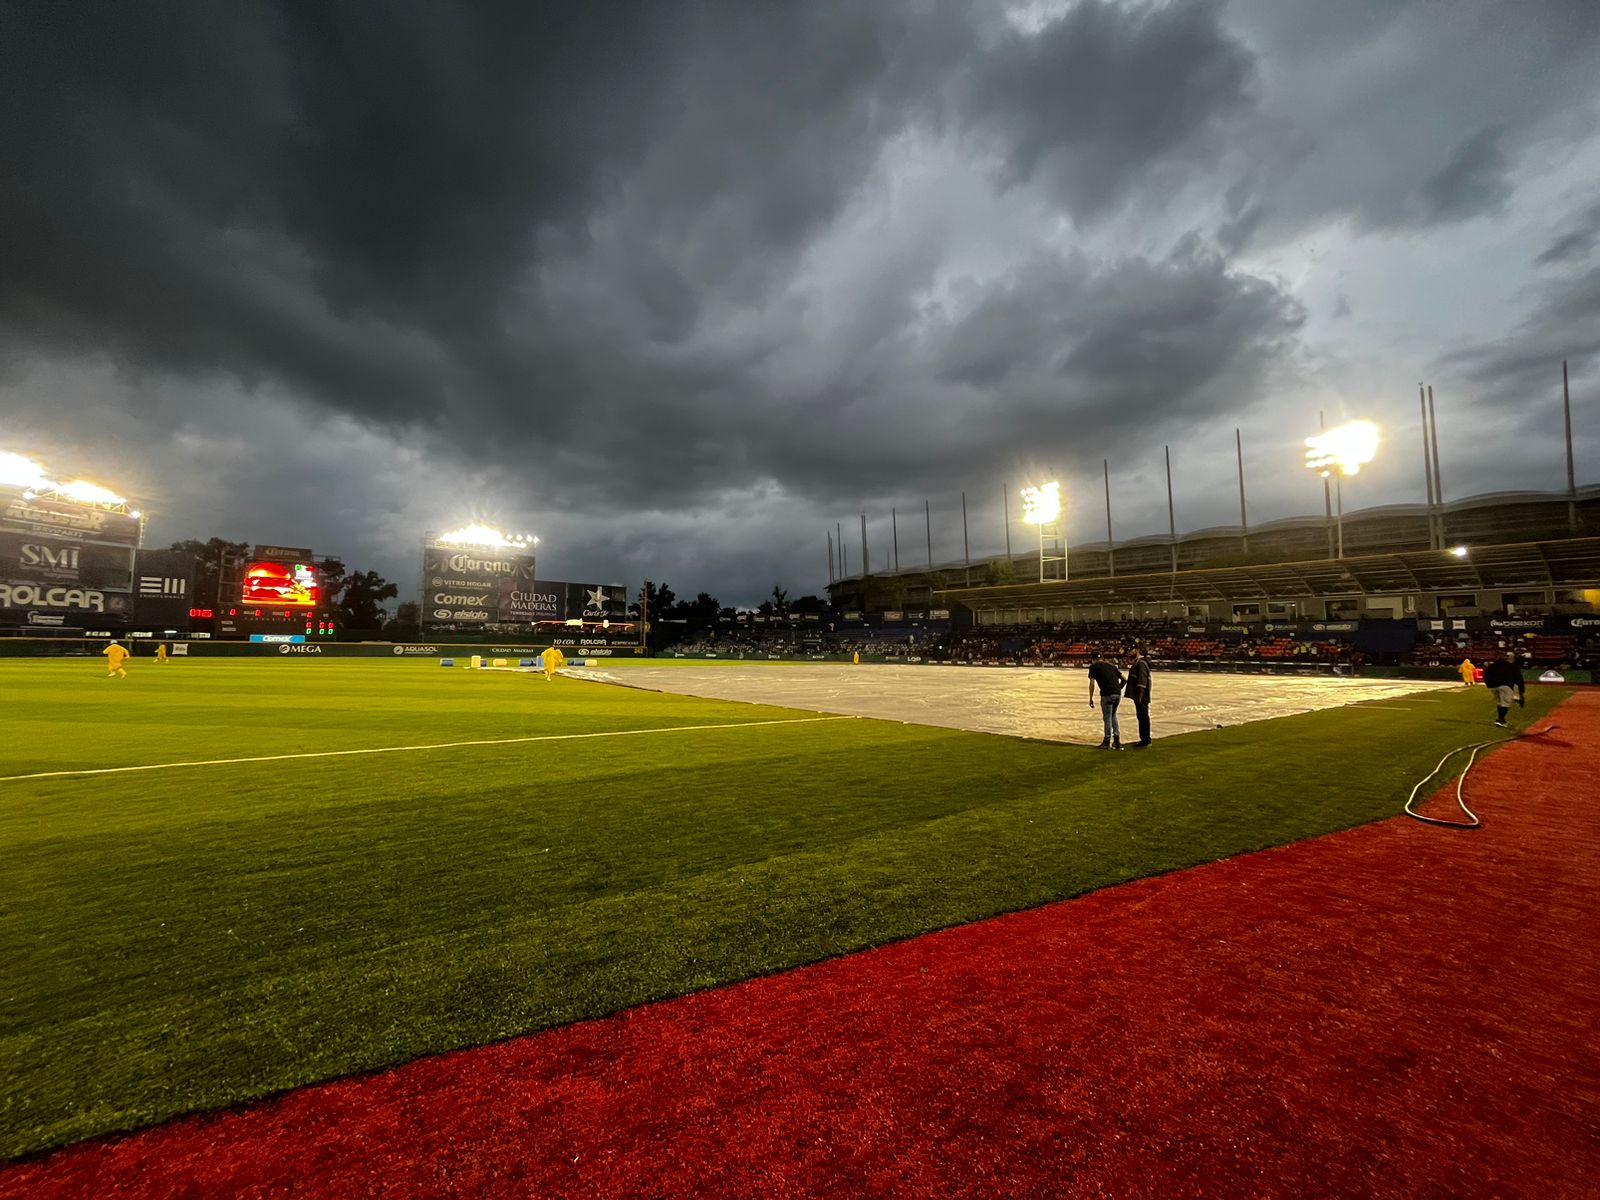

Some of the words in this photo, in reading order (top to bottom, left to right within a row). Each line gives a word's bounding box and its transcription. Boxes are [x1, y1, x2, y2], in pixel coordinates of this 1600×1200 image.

[21, 543, 80, 570] SMI
[449, 554, 511, 574] Corona
[0, 584, 105, 613] ROLCAR
[434, 593, 489, 606] Comex
[510, 591, 557, 603] CIUDAD
[510, 602, 557, 611] MADERAS
[291, 645, 322, 653] MEGA
